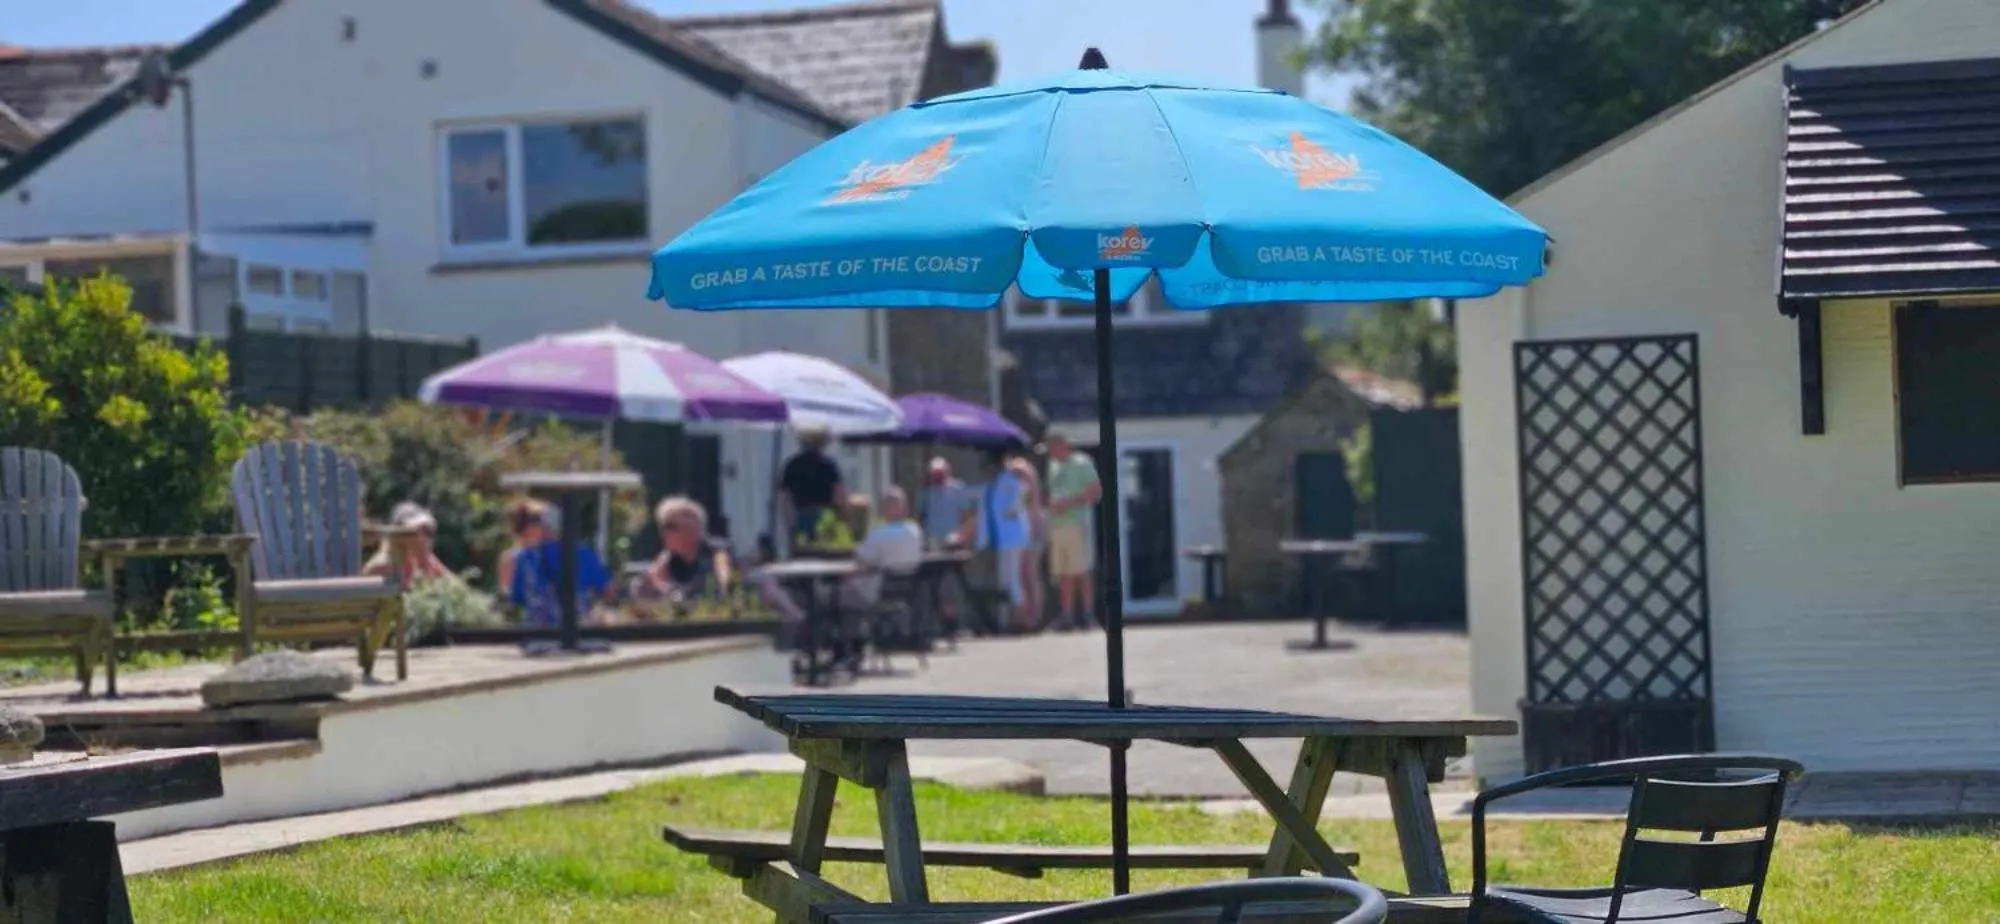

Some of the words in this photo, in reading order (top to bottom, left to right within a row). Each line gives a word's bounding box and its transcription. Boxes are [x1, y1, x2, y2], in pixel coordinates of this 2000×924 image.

[1097, 233, 1156, 250] korev
[1257, 245, 1309, 264] GRAB
[1313, 246, 1327, 261] A
[1329, 246, 1387, 263] TASTE
[1392, 248, 1415, 263] OF
[1418, 249, 1455, 265] THE
[1459, 249, 1520, 271] COAST
[690, 267, 748, 291] GRAB
[751, 266, 767, 281] A
[771, 260, 832, 281] TASTE
[837, 258, 866, 276] OF
[870, 256, 909, 273] THE
[914, 255, 983, 273] COAST
